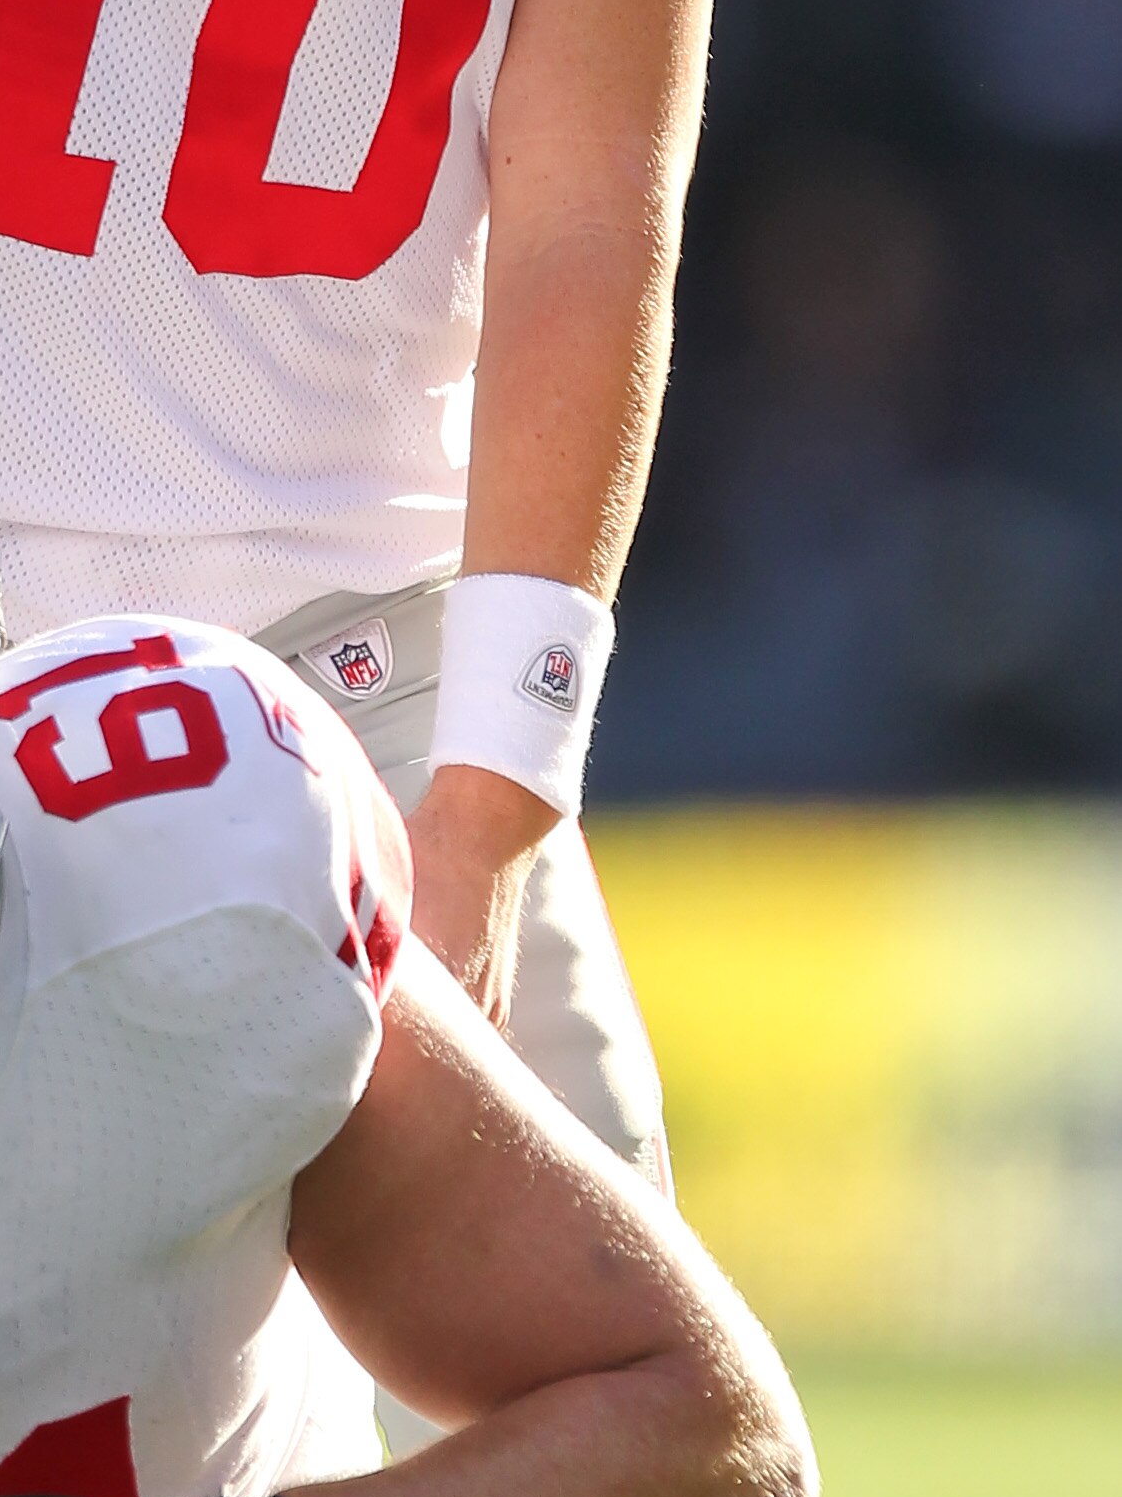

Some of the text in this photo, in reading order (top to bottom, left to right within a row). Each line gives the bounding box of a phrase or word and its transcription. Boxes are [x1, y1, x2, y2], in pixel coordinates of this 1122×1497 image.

[341, 658, 379, 685] NFL
[549, 654, 572, 679] NFL
[526, 680, 575, 708] EQUIPMENT
